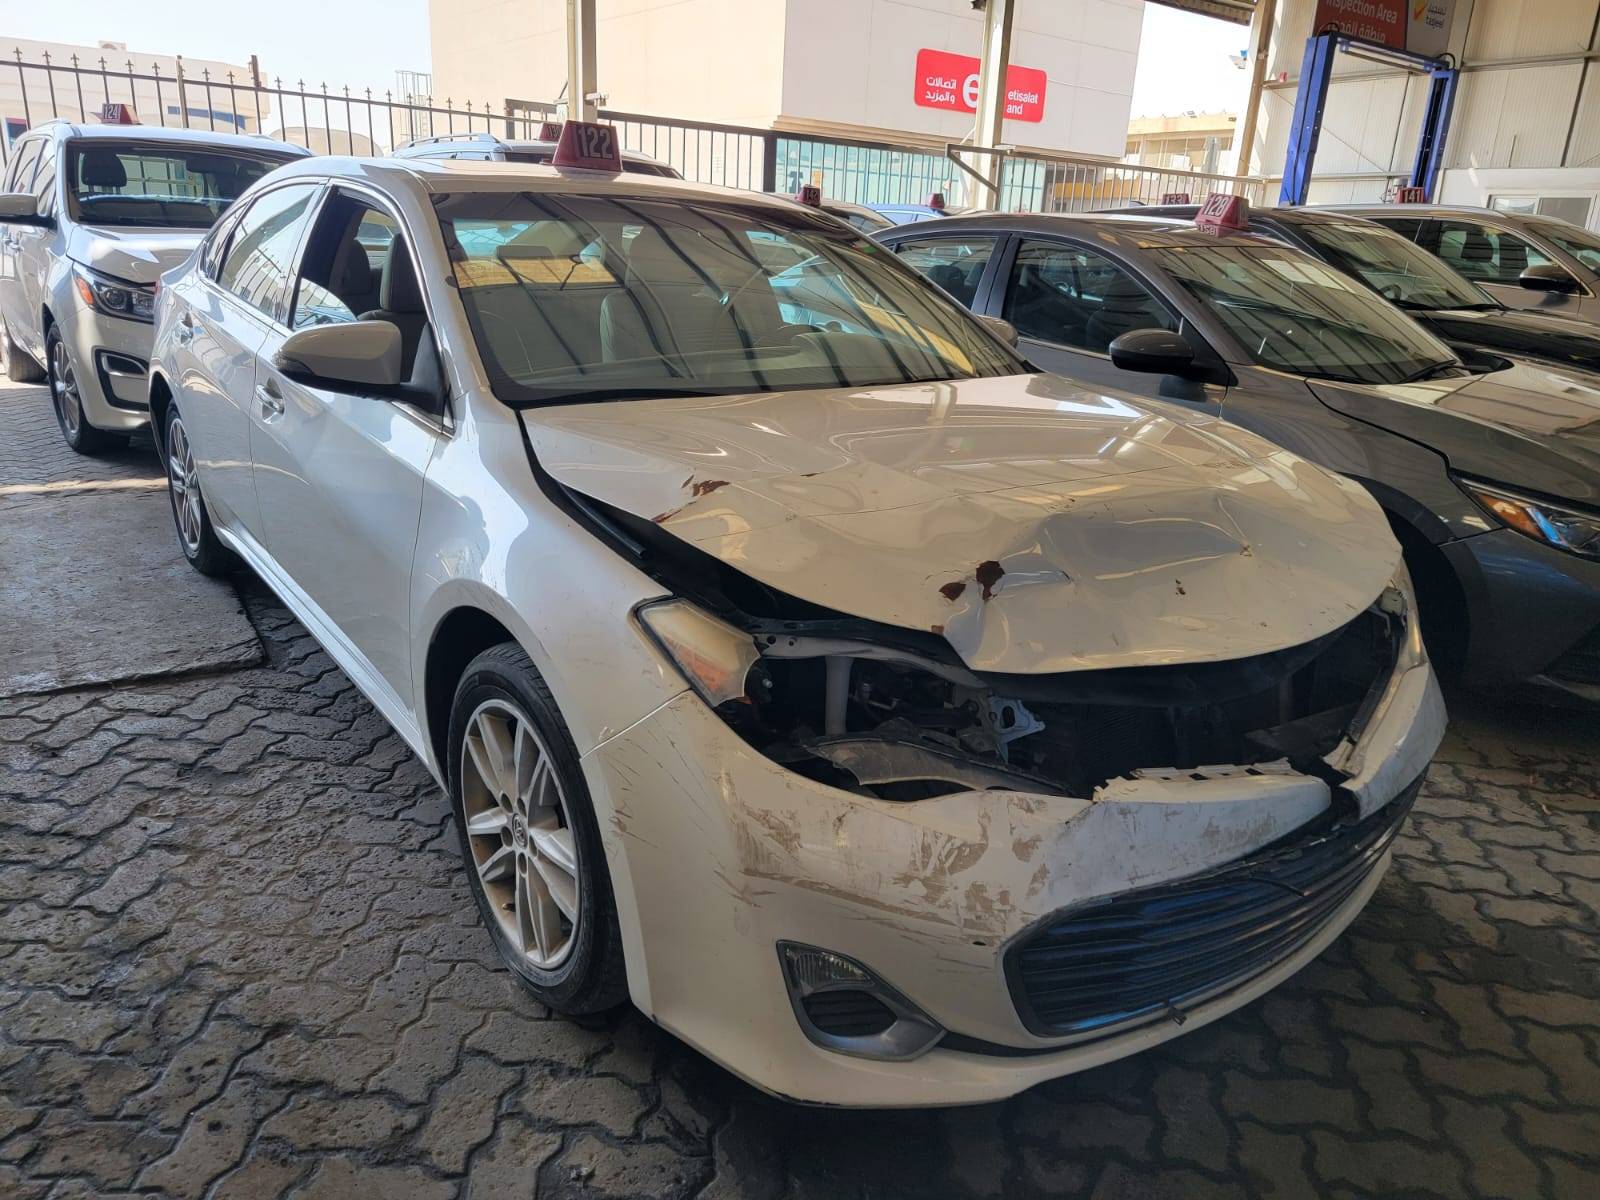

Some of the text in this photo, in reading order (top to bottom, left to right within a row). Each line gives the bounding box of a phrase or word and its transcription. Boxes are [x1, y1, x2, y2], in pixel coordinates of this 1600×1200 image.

[1377, 4, 1398, 24] Area
[925, 89, 956, 105] والمزيد
[1007, 89, 1039, 105] etisalat
[104, 104, 118, 119] 124
[1006, 103, 1023, 115] and
[578, 126, 613, 159] 122
[1404, 189, 1420, 203] 141
[1203, 195, 1229, 217] 128
